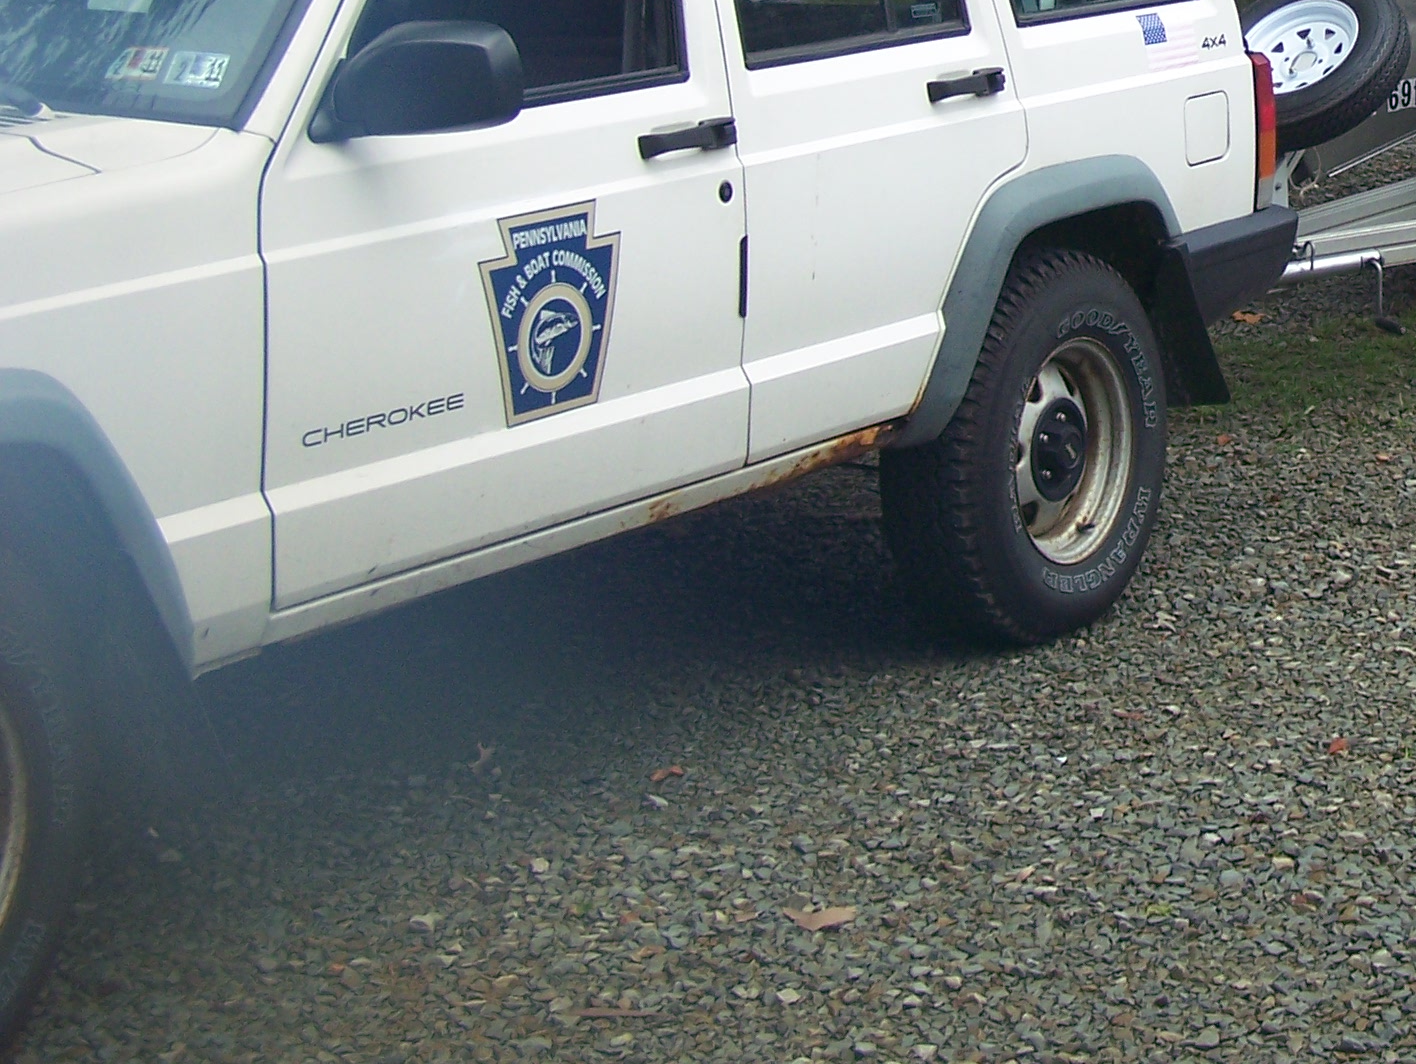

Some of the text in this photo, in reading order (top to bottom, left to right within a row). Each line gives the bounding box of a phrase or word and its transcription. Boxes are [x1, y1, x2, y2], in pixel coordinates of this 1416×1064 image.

[511, 218, 588, 250] PENNSYLVANIA
[501, 249, 607, 319] FISH & BOAT COMMISSION
[1056, 308, 1158, 429] GOODYEAR
[302, 392, 465, 448] CHEROKEE
[1041, 486, 1153, 596] WRANGLER
